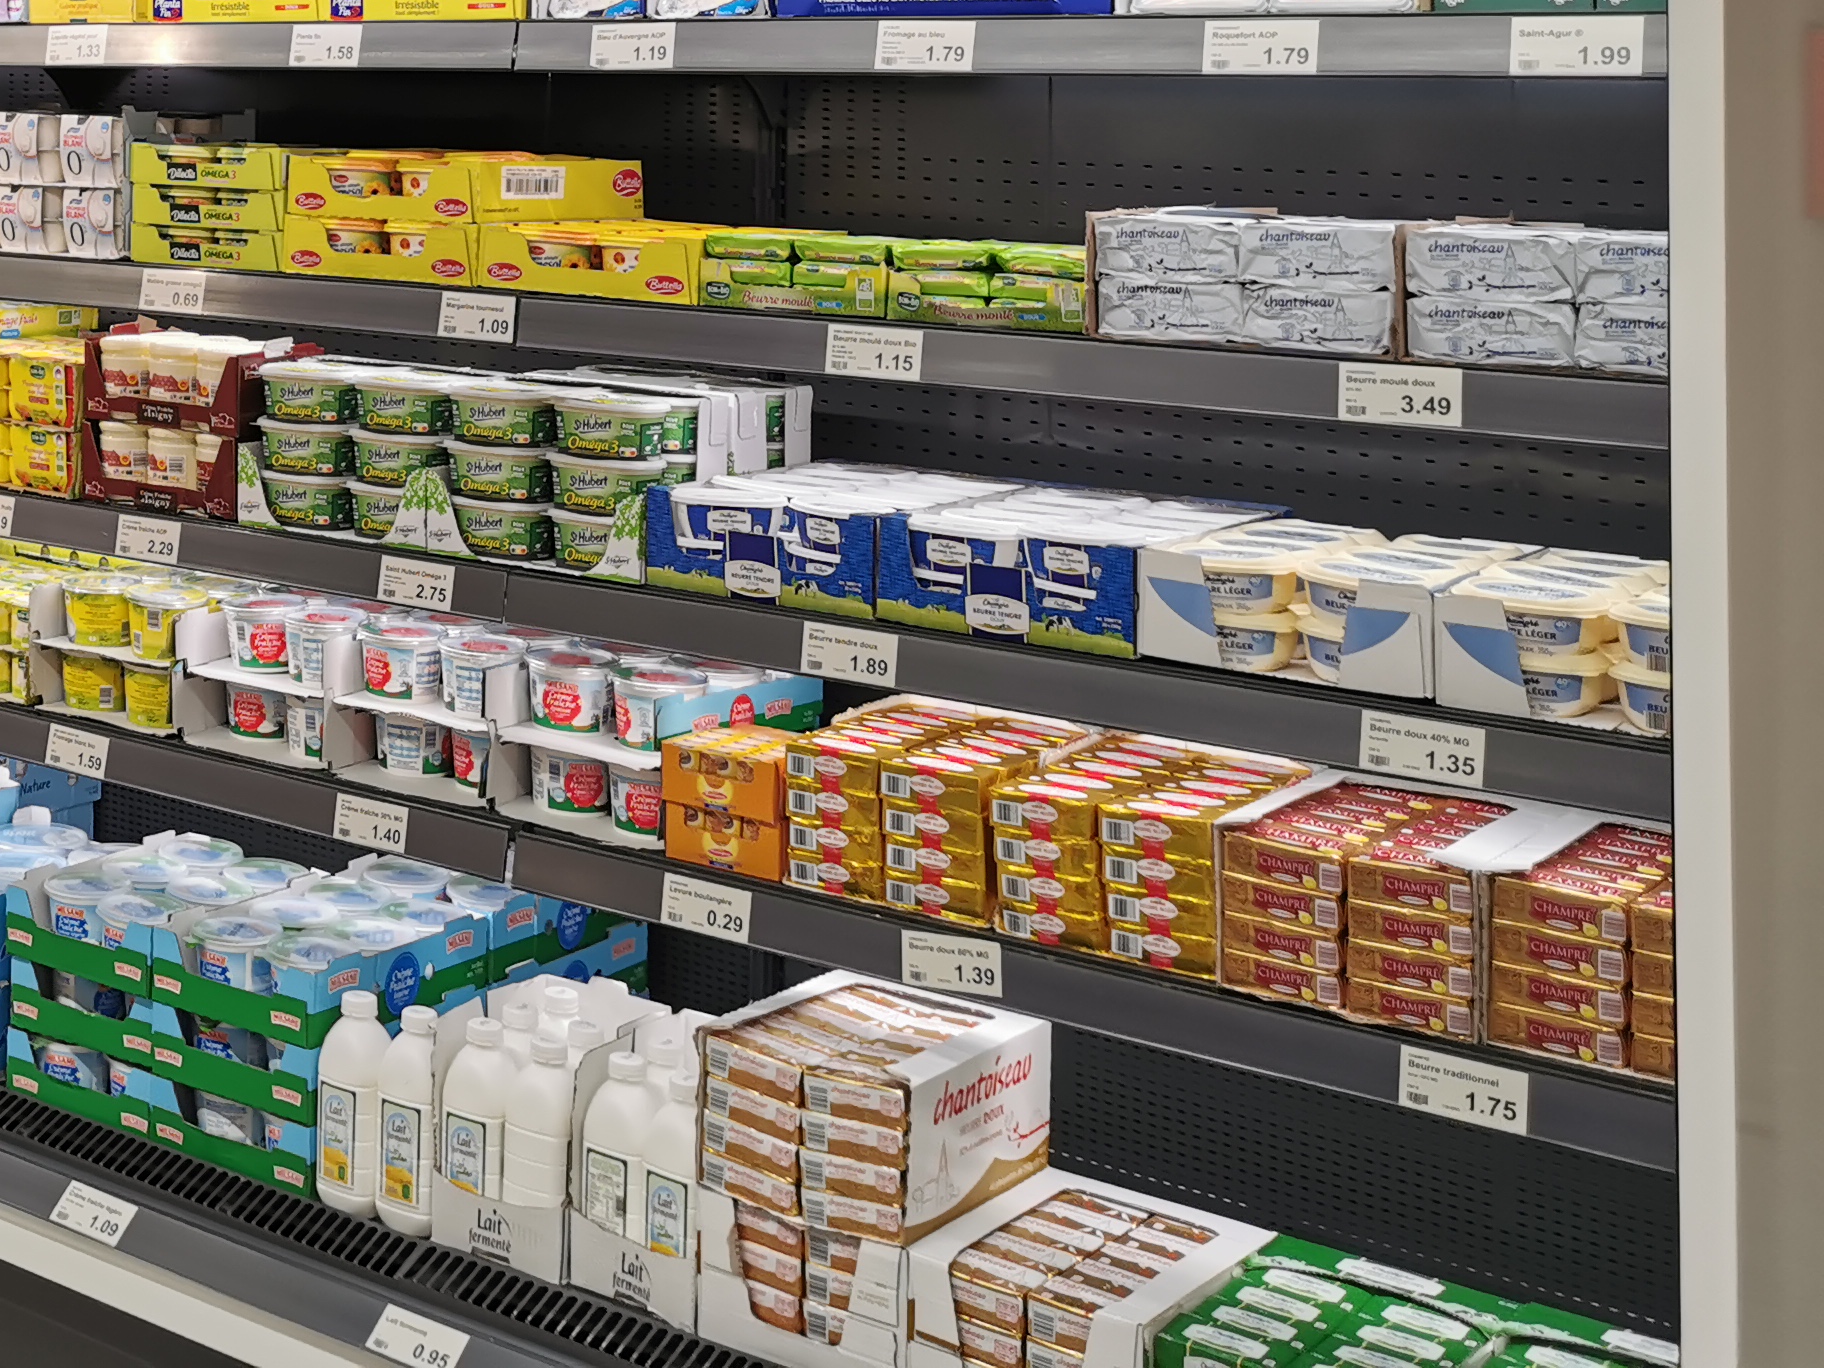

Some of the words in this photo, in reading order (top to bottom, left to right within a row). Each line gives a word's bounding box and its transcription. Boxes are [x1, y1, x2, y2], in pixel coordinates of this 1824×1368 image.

[1518, 29, 1572, 39] Saint-Agur
[76, 44, 101, 58] 1.33
[326, 45, 353, 60] 1.58
[633, 46, 667, 62] 1.19
[925, 45, 965, 62] 1.79
[1263, 47, 1309, 66] 1.79
[1578, 46, 1631, 66] 1.99
[66, 151, 83, 176] 0
[200, 169, 230, 179] OMEGA
[230, 170, 237, 179] 3
[1115, 226, 1180, 241] chantoiseau
[1427, 238, 1505, 254] chantoiseau
[172, 292, 199, 307] 0.69
[742, 290, 780, 306] Beurre
[781, 295, 814, 309] moulé
[1427, 306, 1506, 322] chantoiseau
[478, 318, 509, 335] 1.09
[833, 334, 857, 344] Beurre
[859, 336, 882, 346] moulé
[883, 338, 902, 347] doux
[874, 352, 914, 372] 1.15
[1345, 375, 1378, 385] Beurre
[1379, 376, 1409, 387] moulé
[1411, 378, 1436, 387] doux
[287, 387, 314, 397] Hubert
[275, 402, 312, 418] Oméga
[311, 405, 321, 418] 3
[1401, 395, 1452, 416] 3.49
[147, 539, 173, 556] 2.29
[416, 583, 447, 603] 2.75
[997, 611, 1022, 621] TENDRE
[808, 633, 833, 645] Beurre
[834, 636, 858, 648] tendre
[860, 640, 878, 651] doux
[1529, 628, 1557, 641] LÉGER
[850, 655, 888, 677] 1.89
[1369, 723, 1401, 737] Beurre
[1403, 729, 1428, 741] doux
[1430, 733, 1451, 745] 40%
[1453, 737, 1470, 747] MG
[77, 752, 102, 771] 1.59
[1425, 750, 1475, 777] 1.35
[20, 780, 52, 797] Nature
[371, 824, 401, 845] 1.40
[707, 909, 743, 933] 0.29
[908, 941, 935, 953] Beurre
[935, 945, 955, 955] doux
[954, 964, 995, 986] 1.39
[1408, 1059, 1441, 1074] Beurre
[1442, 1067, 1500, 1089] traditionnel
[933, 1051, 1032, 1125] chantoiseau
[1465, 1091, 1517, 1122] 1.75
[89, 1215, 119, 1237] 1.09
[477, 1208, 502, 1233] Lait
[468, 1229, 512, 1255] fermenté
[621, 1251, 645, 1282] Lait
[612, 1271, 652, 1301] fermenté
[413, 1343, 451, 1368] 0.95
